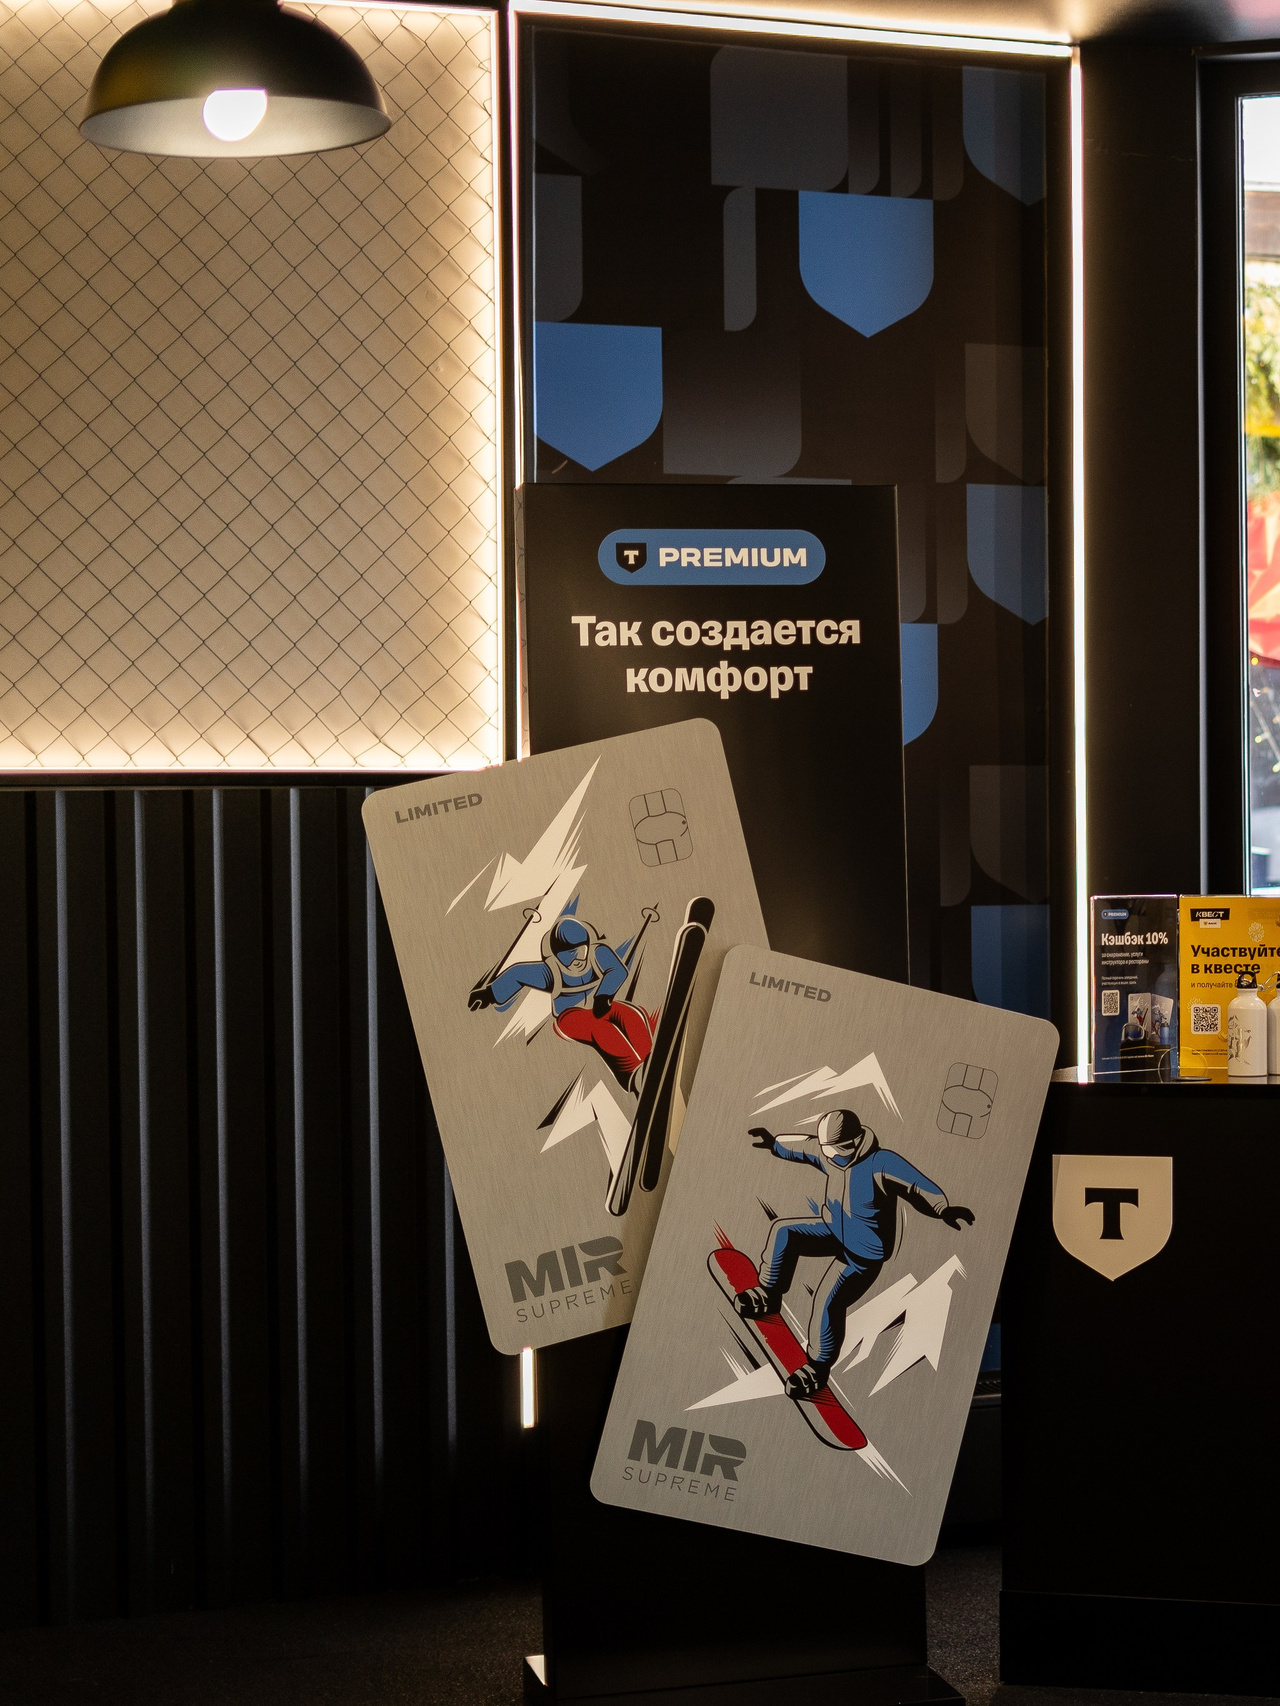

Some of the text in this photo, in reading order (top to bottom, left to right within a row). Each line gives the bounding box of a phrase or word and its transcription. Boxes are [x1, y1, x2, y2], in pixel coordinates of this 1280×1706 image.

[659, 548, 807, 567] PREMIUM
[571, 615, 861, 650] Так создается
[626, 660, 813, 699] комфорт
[394, 793, 483, 824] LIMITED
[1101, 931, 1169, 946] Кэшбэк 10%
[1191, 963, 1260, 974] в квесте
[1196, 981, 1233, 989] получайте
[749, 971, 831, 1002] LIMITED
[1085, 1187, 1139, 1240] T
[504, 1235, 628, 1303] MIR
[516, 1279, 633, 1323] SUPREME
[627, 1419, 747, 1482] MIR
[622, 1466, 737, 1502] SUPREME
